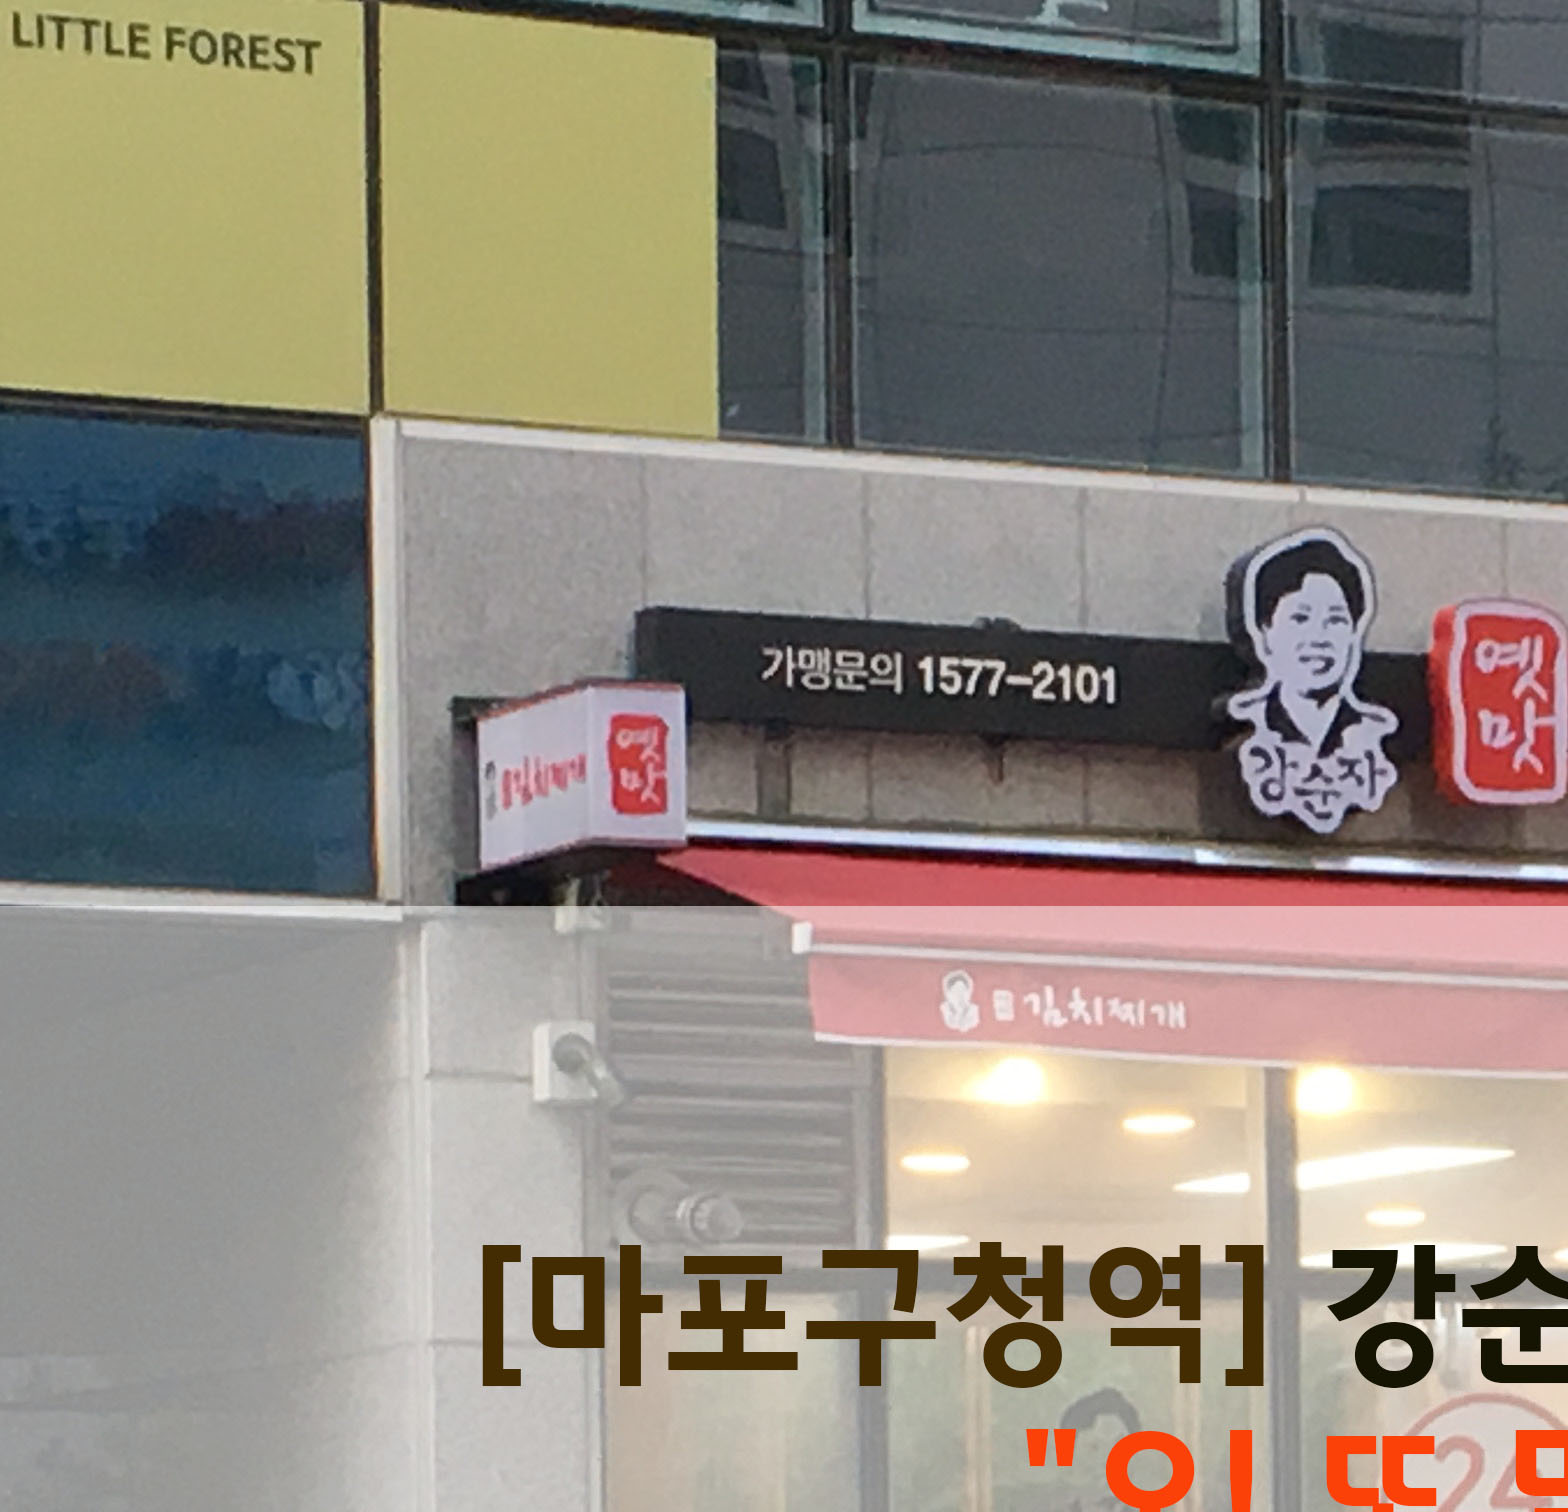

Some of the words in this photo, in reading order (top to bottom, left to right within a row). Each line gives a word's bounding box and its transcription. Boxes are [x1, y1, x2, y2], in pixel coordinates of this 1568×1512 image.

[12, 11, 151, 60] LITTLE
[165, 25, 322, 75] FOREST
[761, 645, 903, 694] 가맹문의
[917, 655, 1117, 704] 1577-2101
[1475, 634, 1555, 775] 옛맛
[1249, 745, 1388, 820] 강순자
[1023, 985, 1187, 1029] 김치찌개
